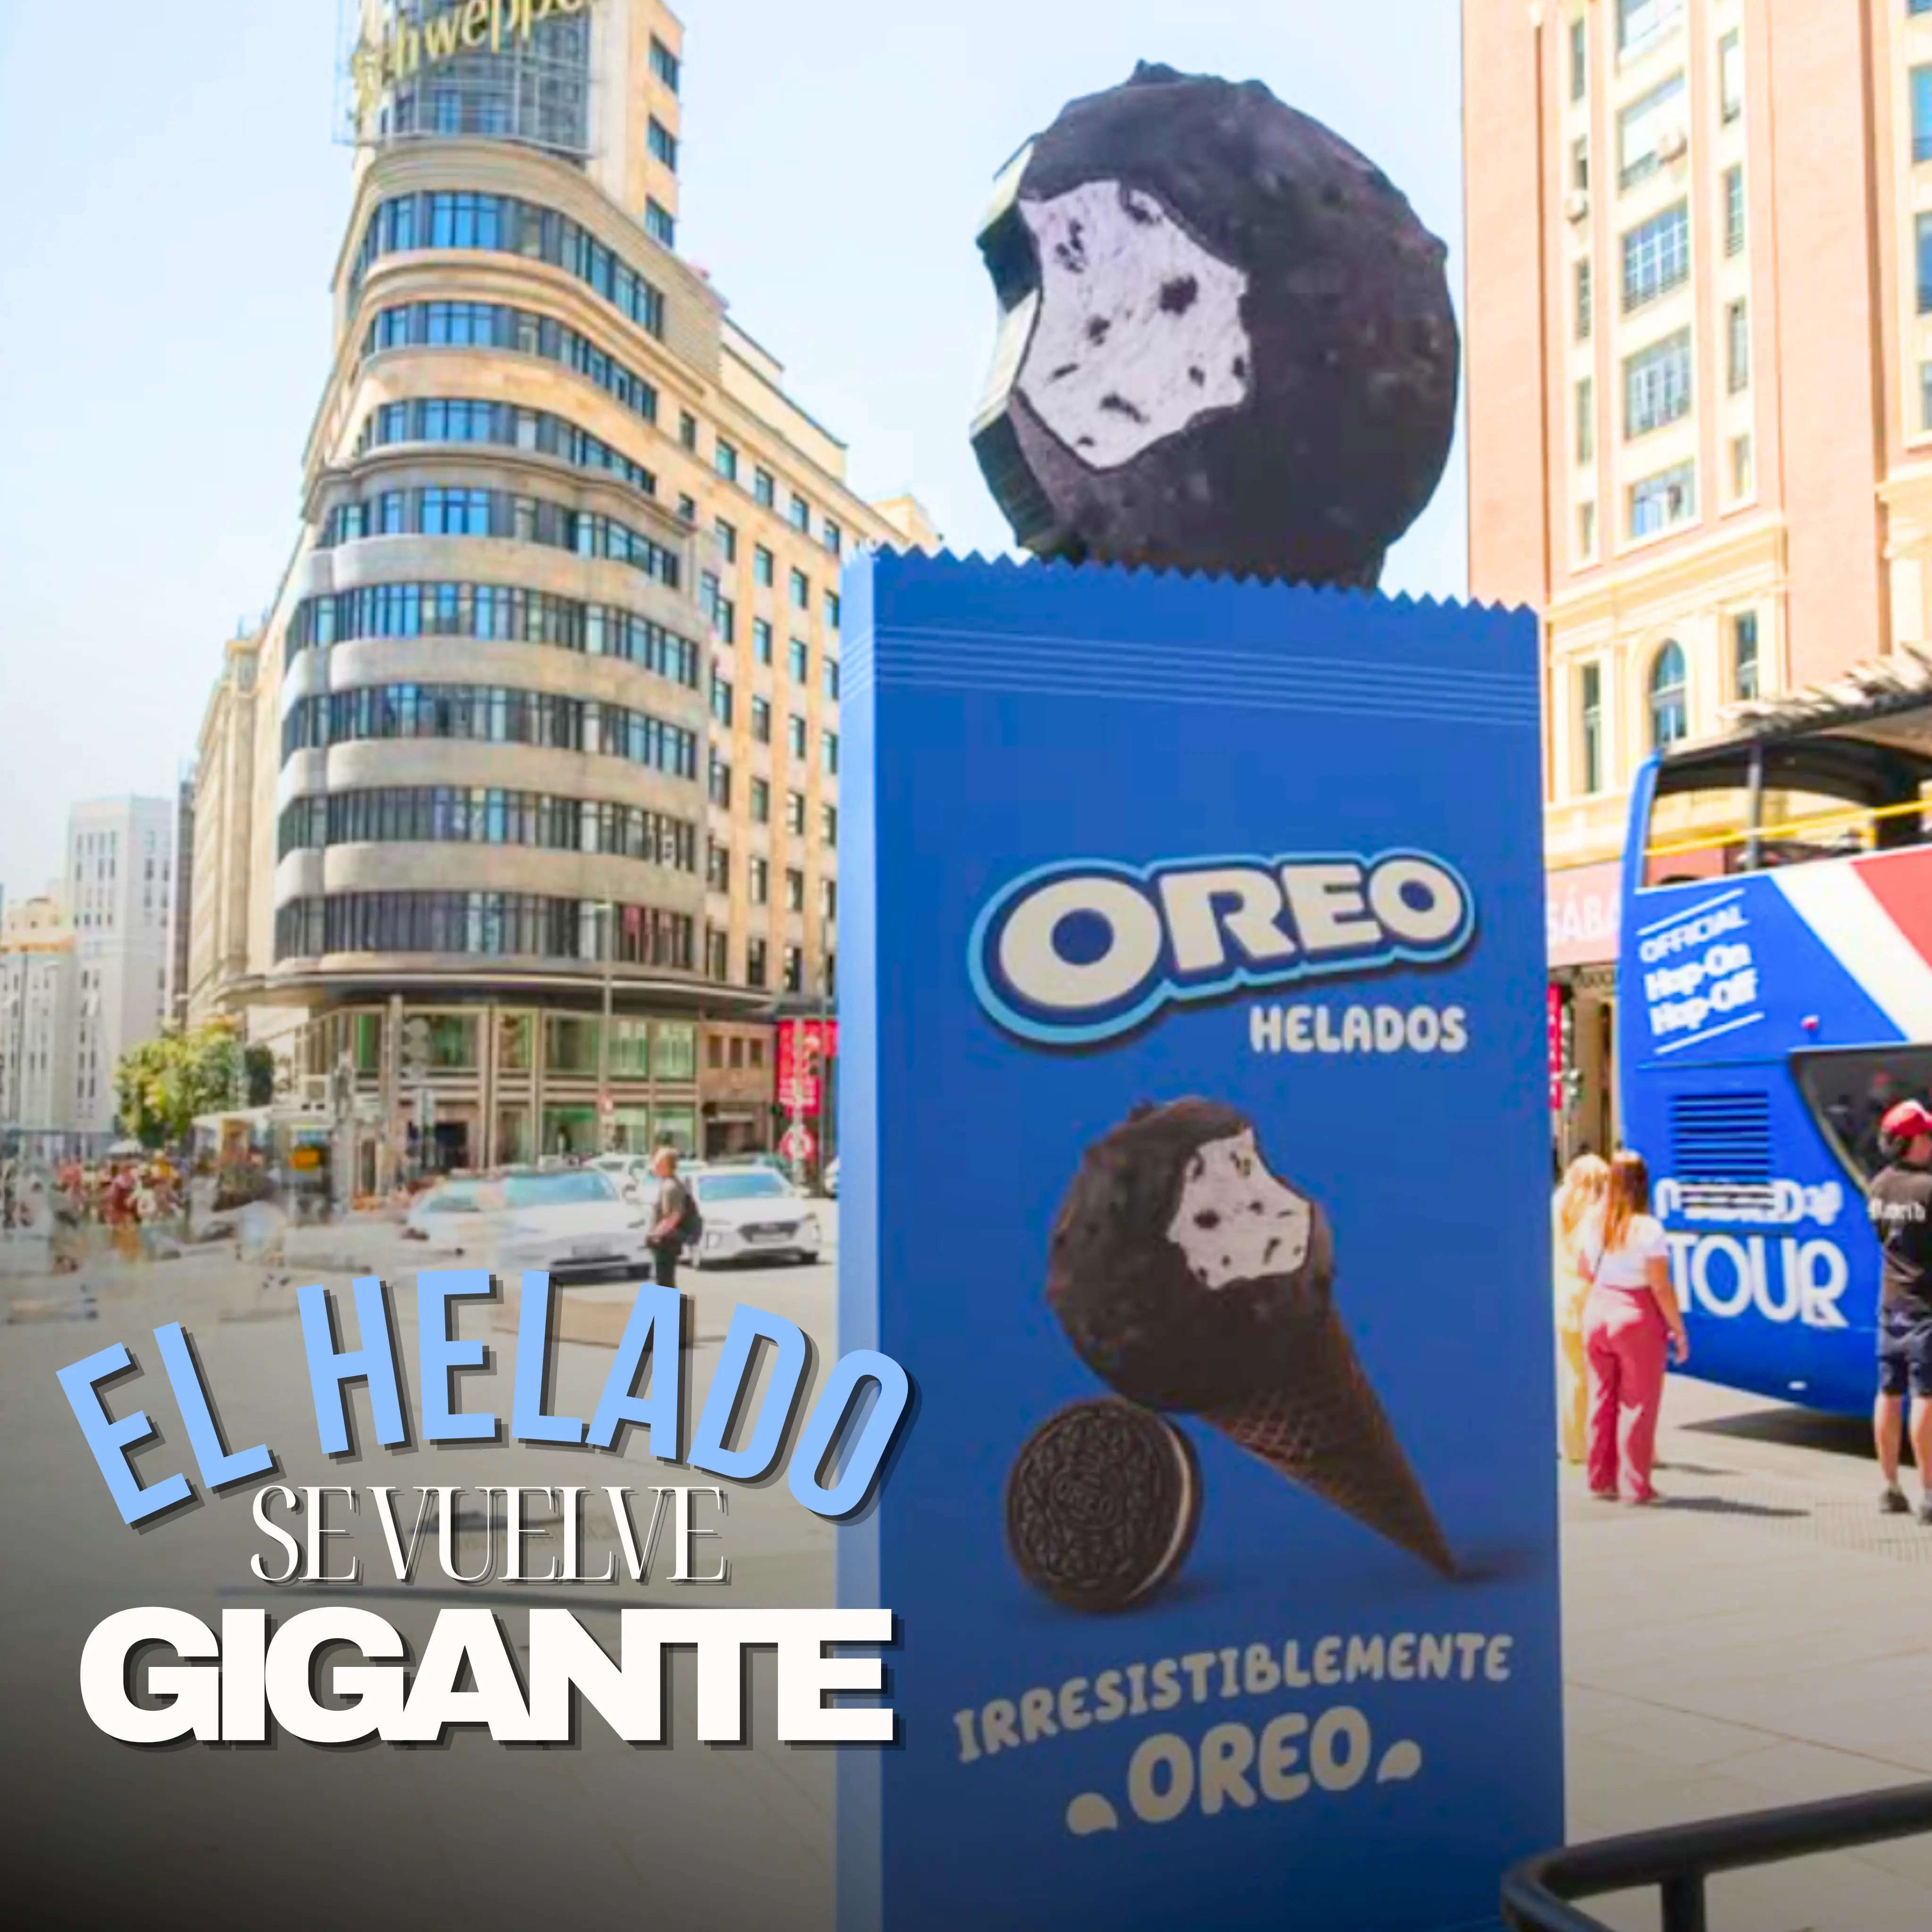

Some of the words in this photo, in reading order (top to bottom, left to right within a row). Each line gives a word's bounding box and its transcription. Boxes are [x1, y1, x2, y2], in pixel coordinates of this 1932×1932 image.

[999, 859, 1462, 1008] OREO
[1640, 906, 1748, 963] OFFICIAL
[1249, 1005, 1468, 1053] HELADOS
[1665, 1234, 1848, 1328] TOUR
[953, 1632, 1513, 1762] IRRESISTIBLEMENTE
[1127, 1706, 1372, 1823] OREO
